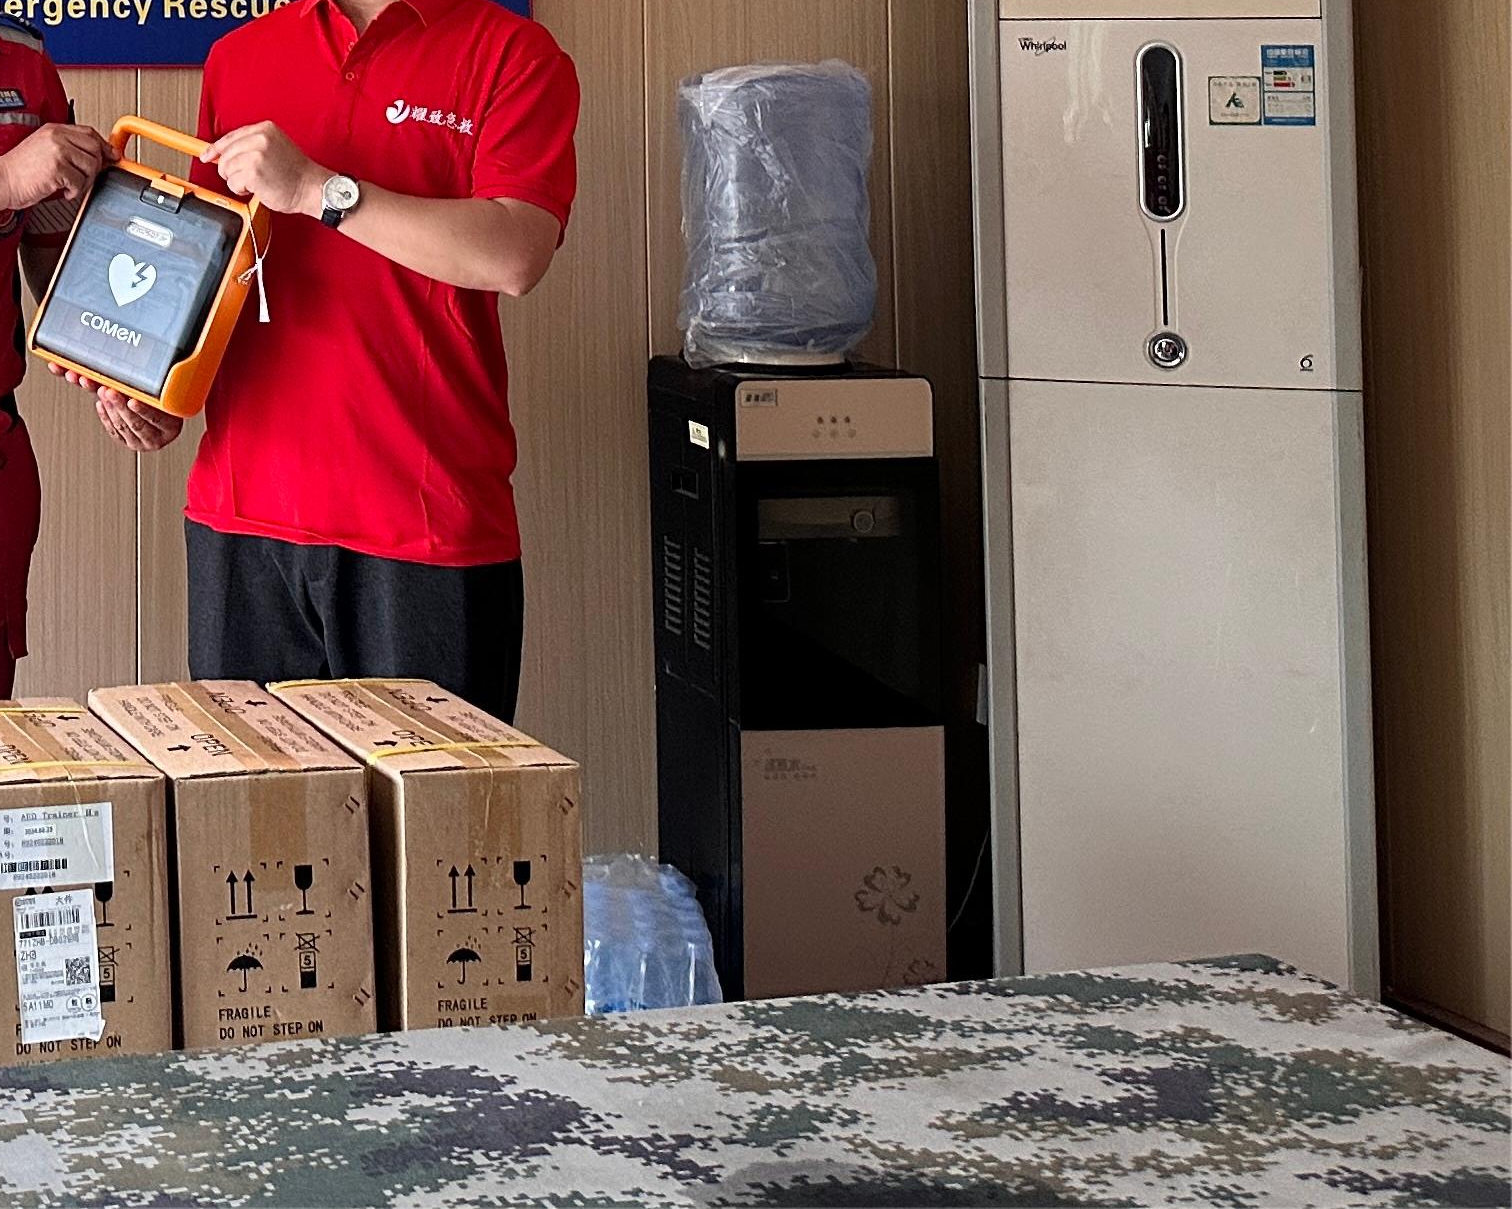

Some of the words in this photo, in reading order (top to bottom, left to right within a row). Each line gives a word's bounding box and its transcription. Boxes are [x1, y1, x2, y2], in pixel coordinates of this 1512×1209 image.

[1018, 37, 1067, 53] Whirlpool
[218, 1005, 271, 1022] FRAGILE
[437, 998, 488, 1012] FRAGILE
[219, 1027, 235, 1040] DO
[242, 1025, 264, 1038] NOT
[273, 1021, 303, 1036] STEP
[308, 1020, 324, 1033] ON
[16, 1043, 32, 1055] DO
[40, 1040, 62, 1053] NOT
[106, 1035, 122, 1048] ON
